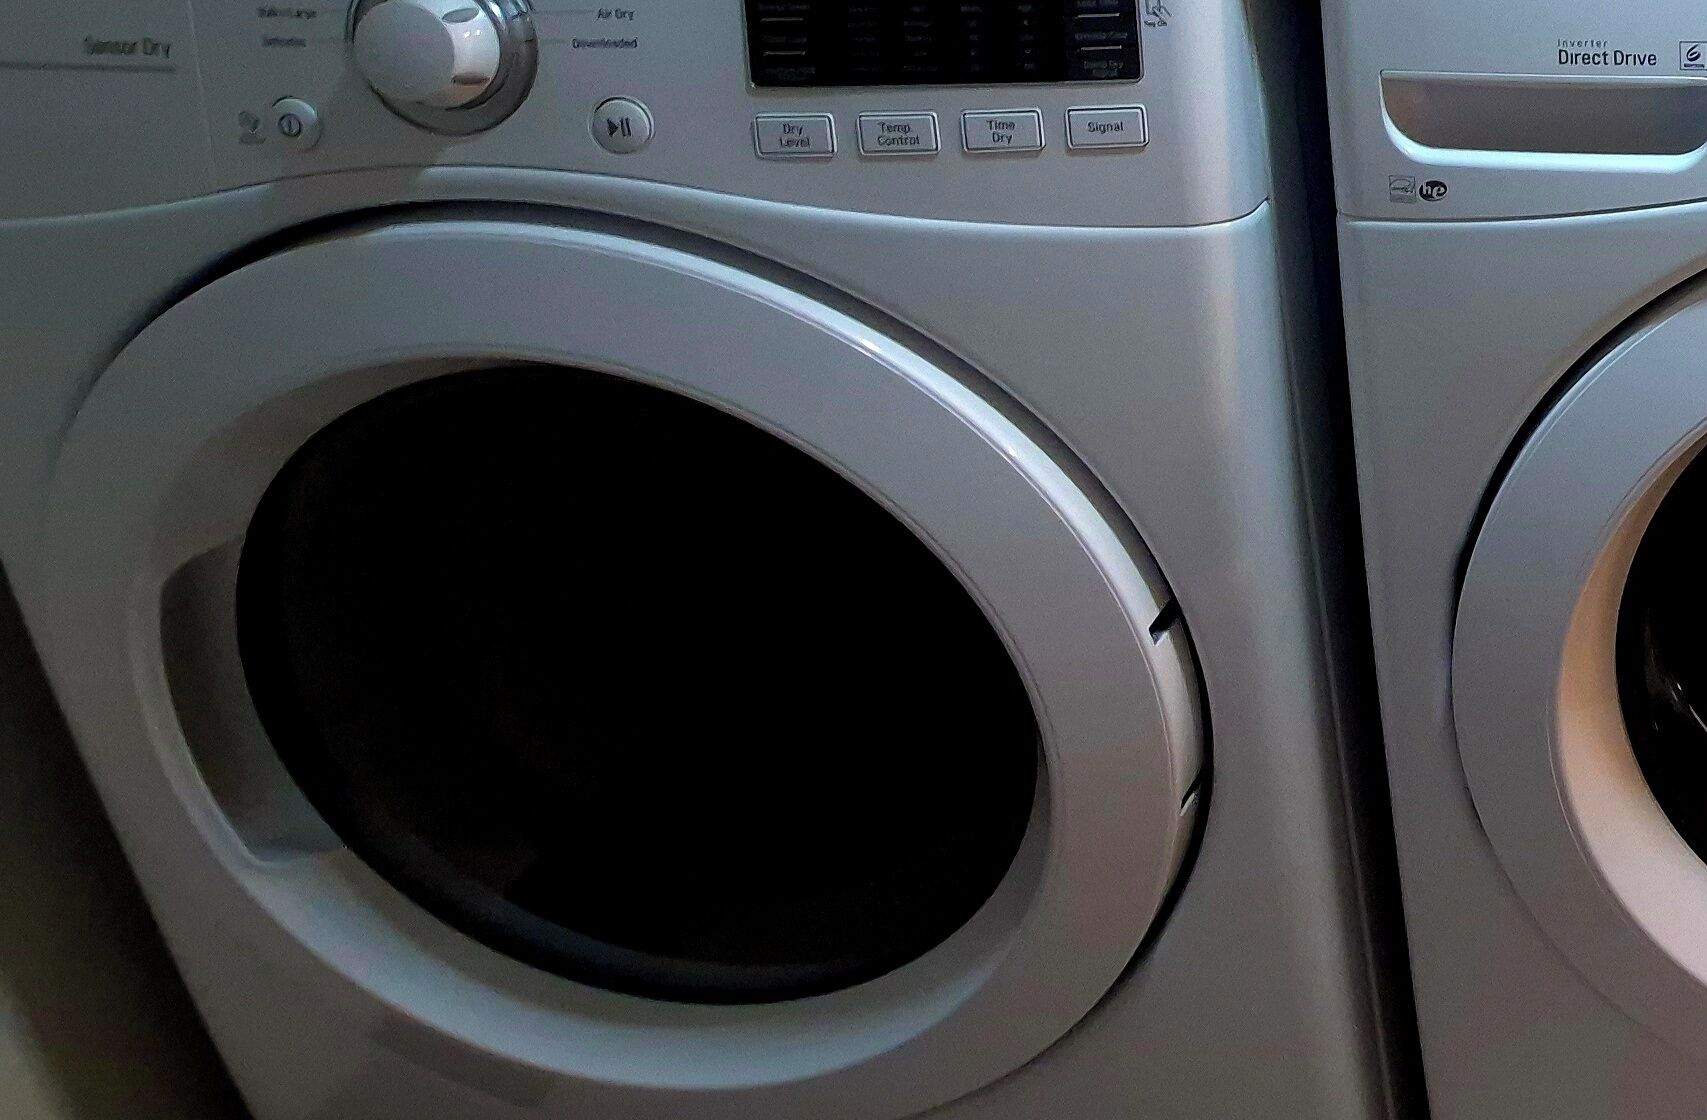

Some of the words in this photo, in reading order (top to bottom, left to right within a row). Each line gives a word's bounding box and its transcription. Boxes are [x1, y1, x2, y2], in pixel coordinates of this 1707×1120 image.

[142, 36, 171, 59] Dry
[1557, 38, 1609, 48] Inverter
[1558, 49, 1609, 66] Direct
[1614, 50, 1657, 66] Drive
[783, 123, 804, 136] Dry
[878, 121, 911, 134] Temp
[986, 120, 1016, 131] Time
[1087, 121, 1124, 134] Signal
[779, 137, 810, 148] Level
[877, 136, 920, 147] Control
[992, 132, 1012, 144] Dry
